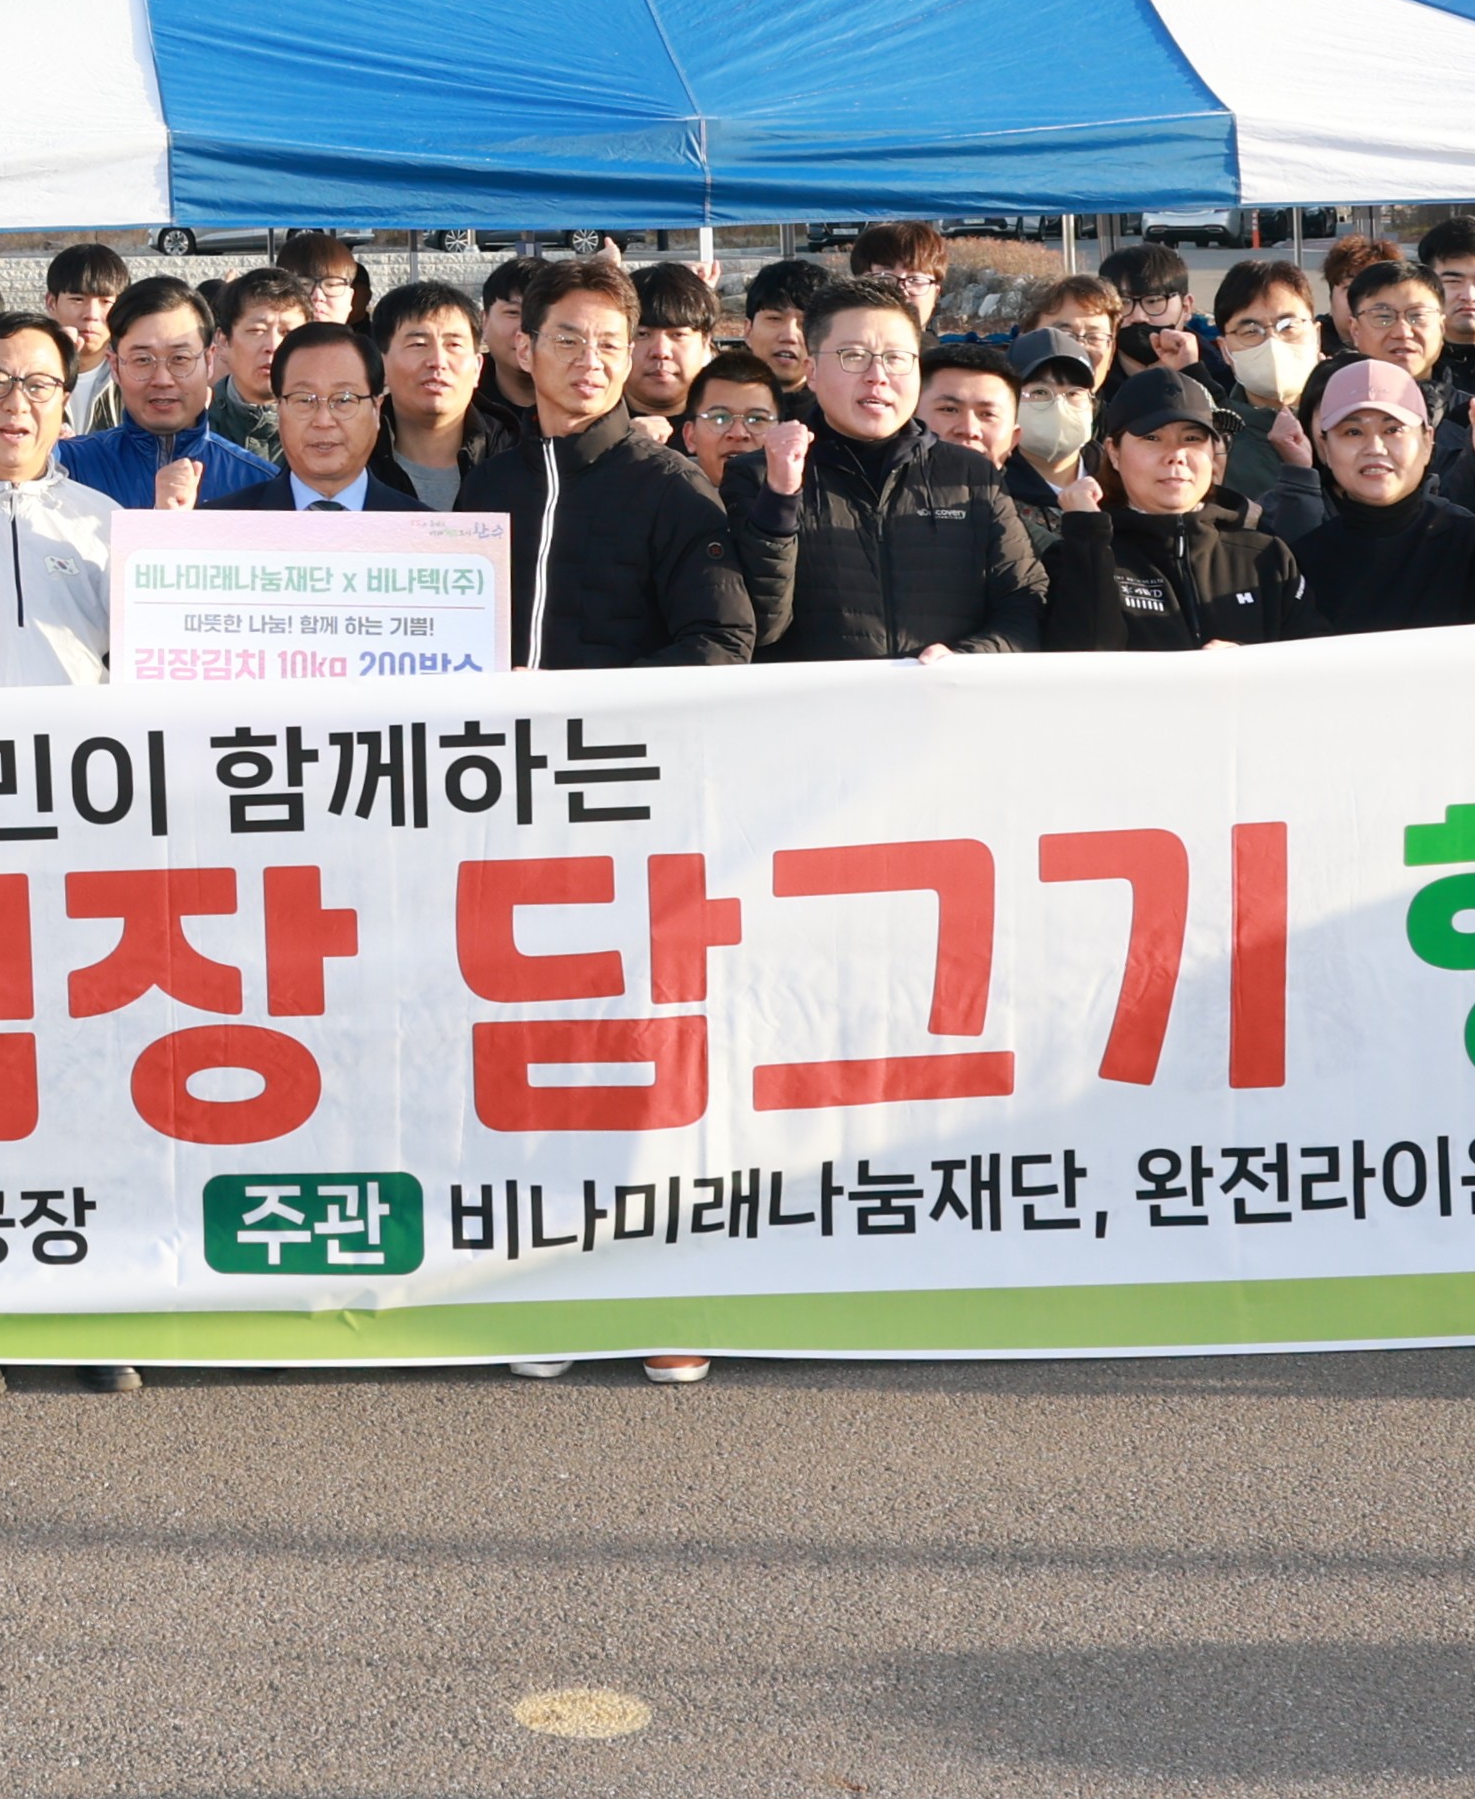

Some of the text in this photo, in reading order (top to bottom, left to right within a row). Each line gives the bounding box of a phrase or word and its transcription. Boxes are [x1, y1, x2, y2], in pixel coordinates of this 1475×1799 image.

[135, 564, 334, 594] 비나미래나눔재단
[366, 567, 484, 596] 비나텍(주)
[134, 648, 266, 681] 김장김치
[184, 613, 435, 637] 따뜻한 나눔! 함께 하는 기쁨!
[211, 719, 659, 833] 함께하는
[457, 823, 1286, 1131] 담그기
[238, 1182, 389, 1264] 주관
[451, 1150, 1107, 1259] 비나미래나눔재단,
